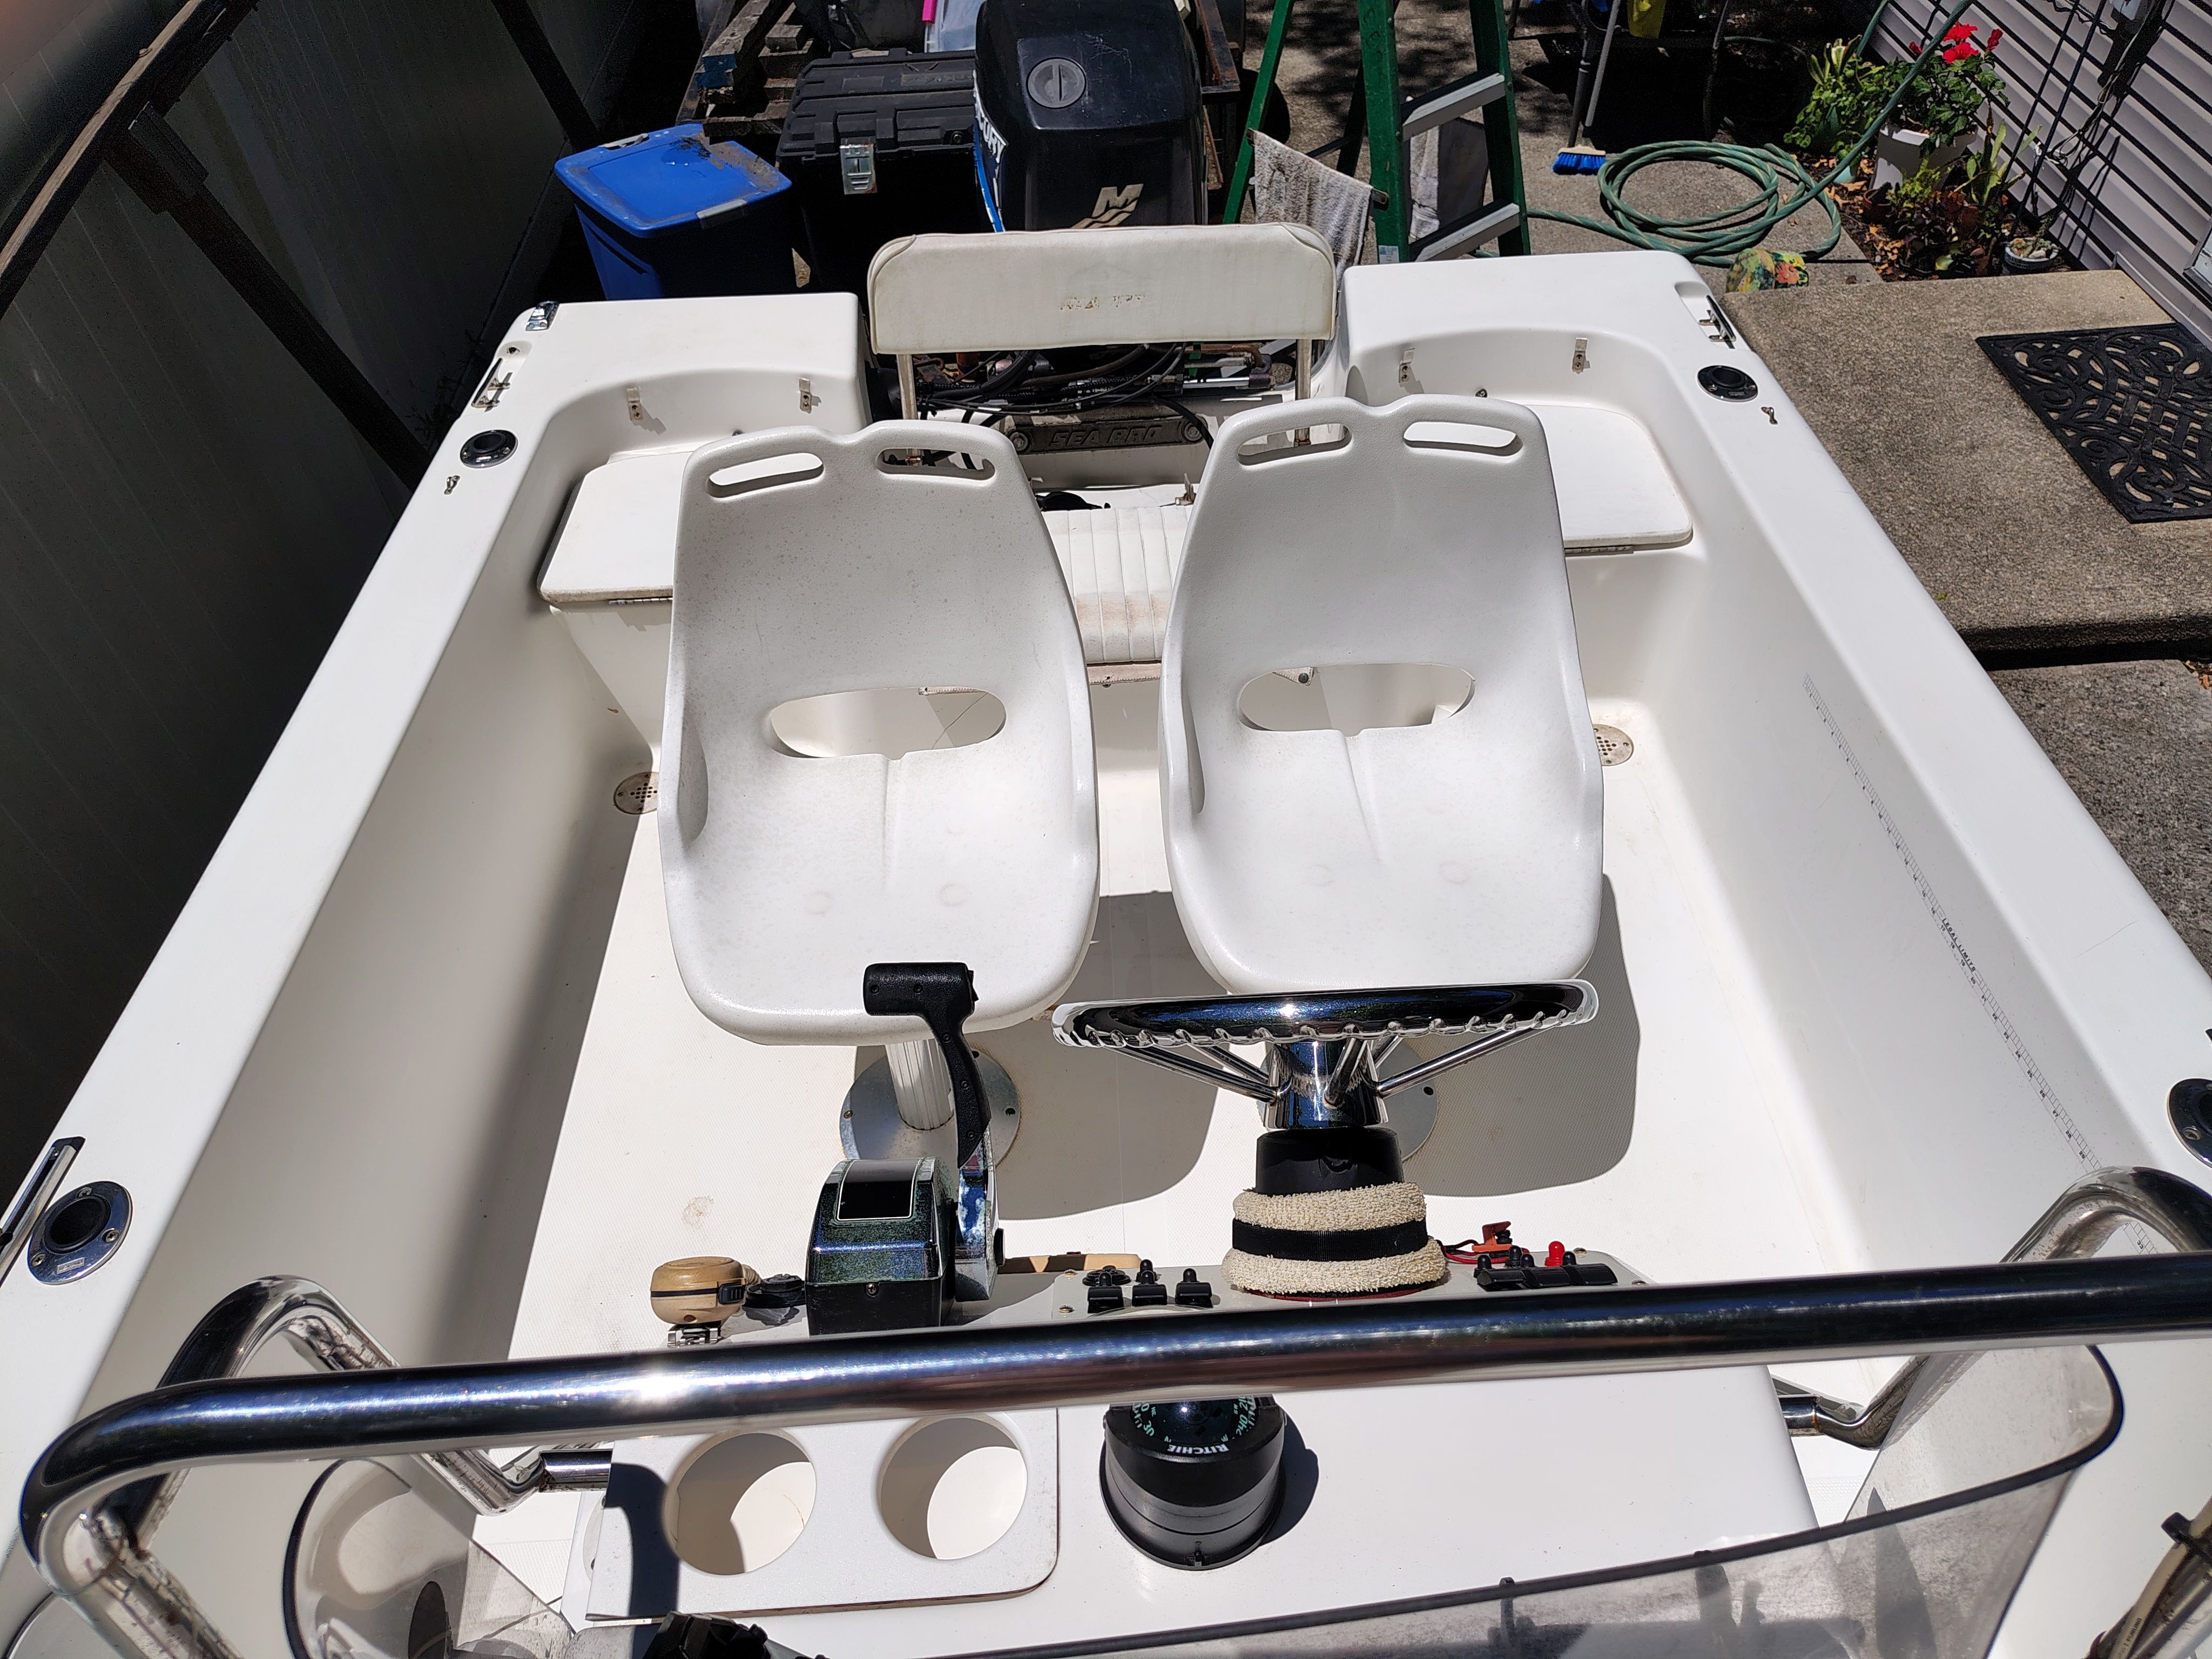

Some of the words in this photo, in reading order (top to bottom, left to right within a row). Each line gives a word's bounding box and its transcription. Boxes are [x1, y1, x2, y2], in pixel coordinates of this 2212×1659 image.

[1050, 430, 1100, 447] SEA
[1108, 426, 1162, 443] PRO
[1942, 918, 1958, 941] LEGAL
[1959, 945, 1976, 972] LIMITS
[2137, 1240, 2143, 1249] 33
[1143, 1420, 1155, 1437] 30
[1236, 1414, 1248, 1436] 240
[1166, 1443, 1230, 1454] RITCHIE
